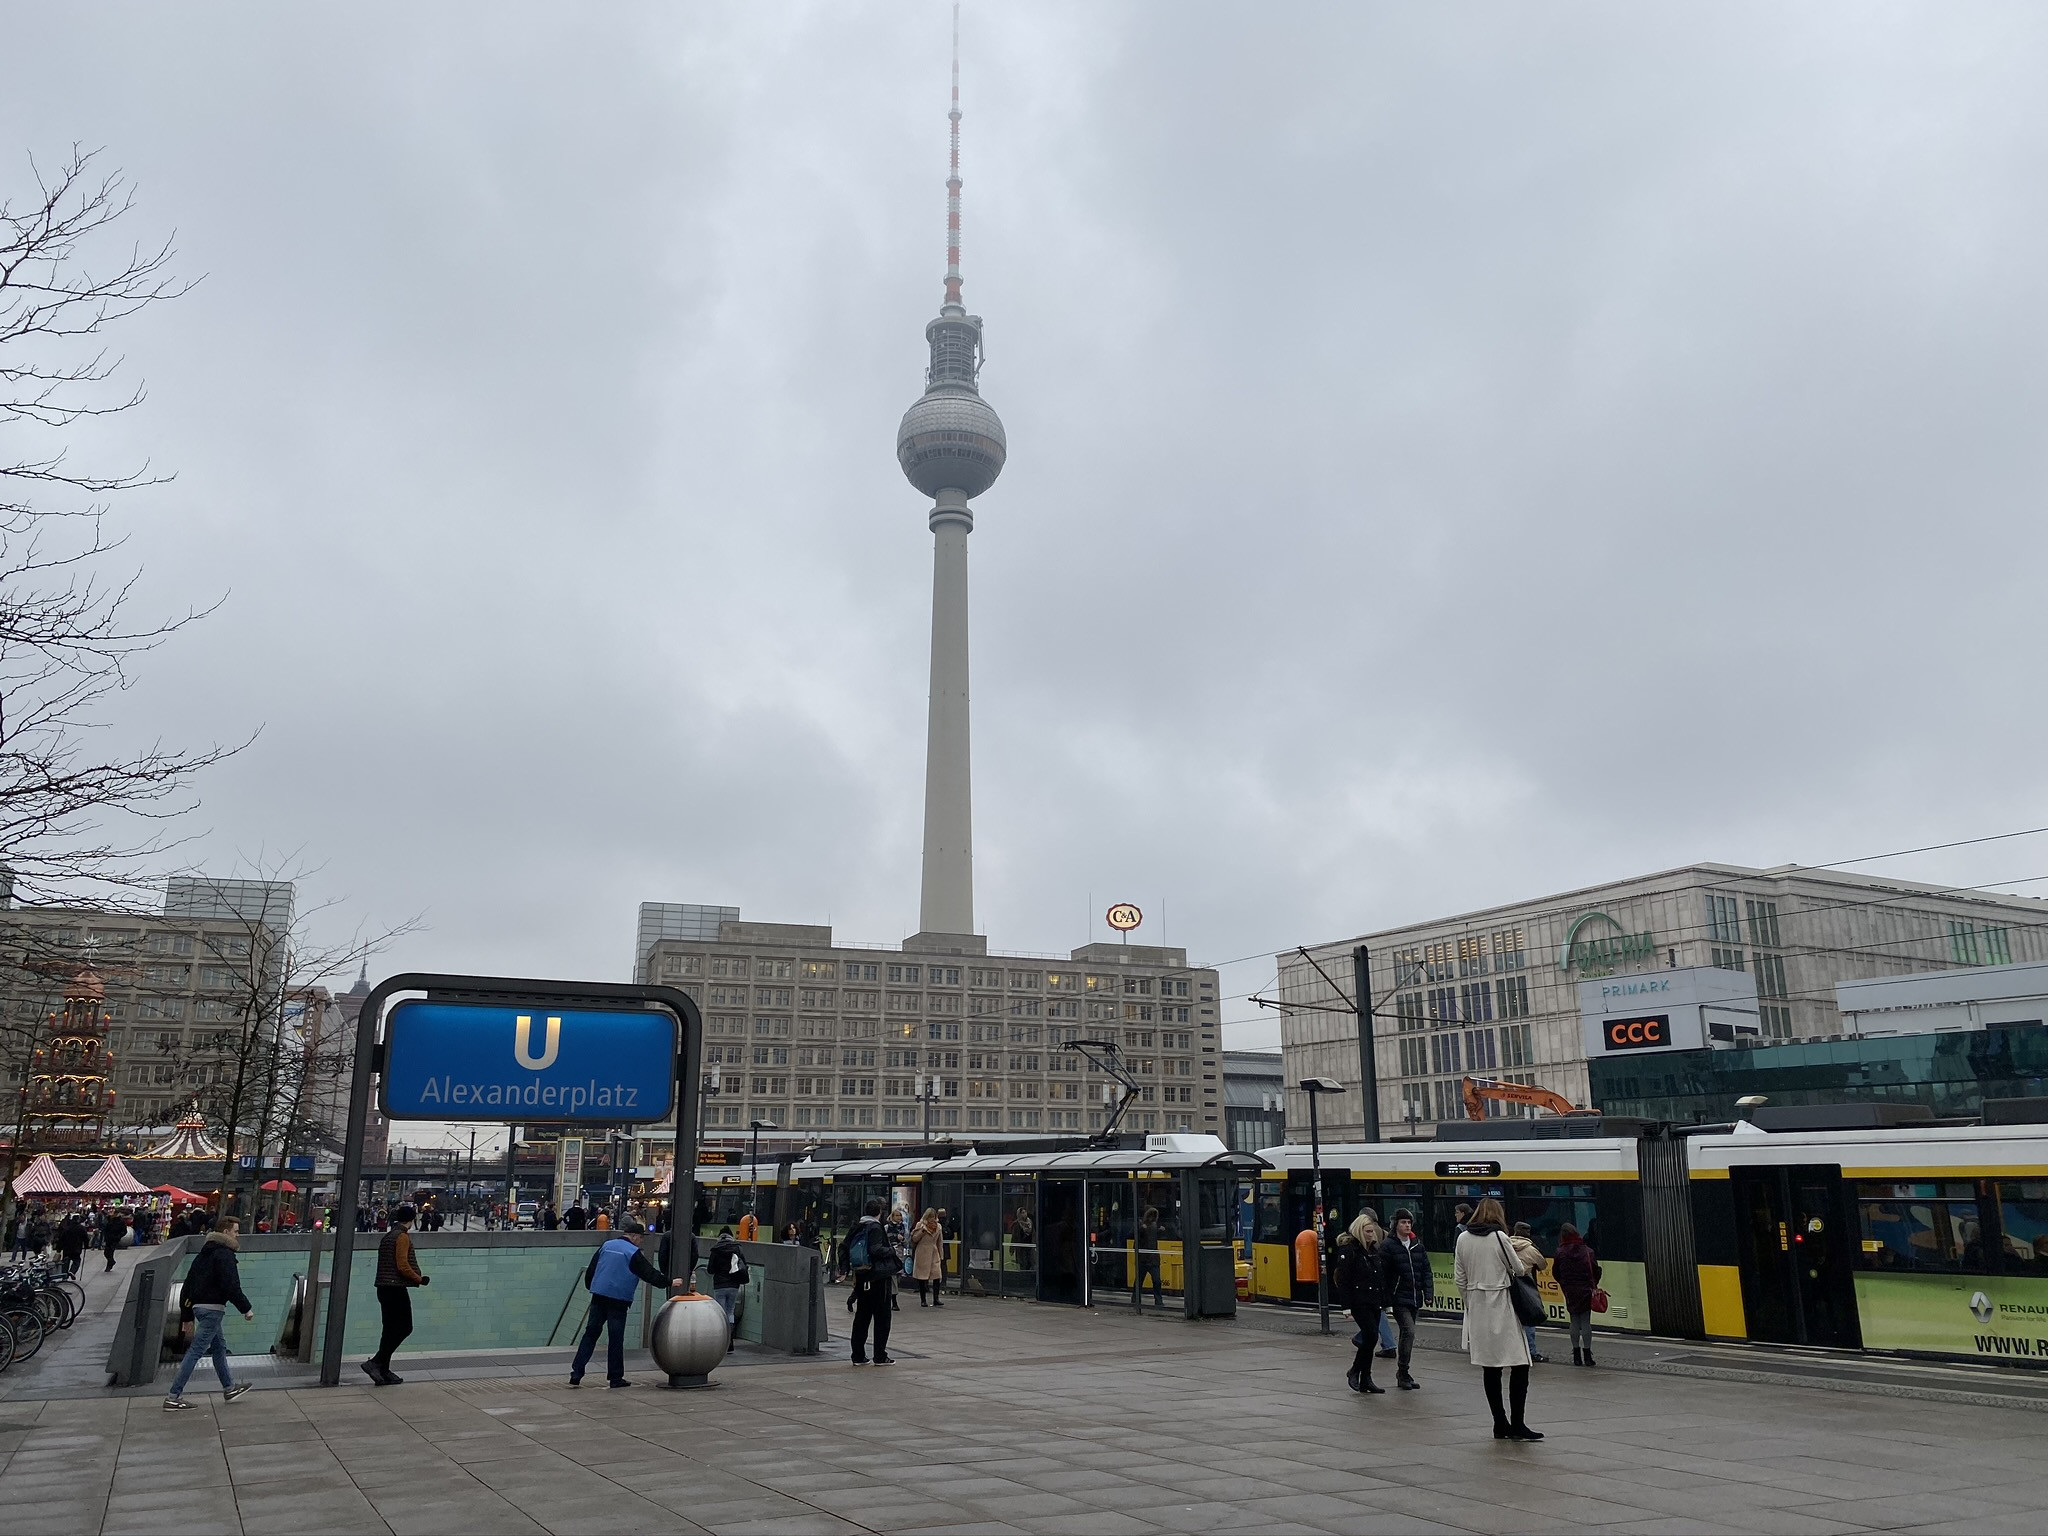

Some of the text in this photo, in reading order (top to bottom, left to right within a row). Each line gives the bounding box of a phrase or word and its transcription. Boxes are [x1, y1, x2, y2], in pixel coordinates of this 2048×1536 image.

[1112, 910, 1137, 923] C&A
[1574, 930, 1657, 973] GALERIA
[1602, 979, 1671, 998] PRIMARK
[514, 1015, 561, 1070] U
[1611, 1021, 1660, 1044] CCC
[419, 1075, 638, 1113] Alexanderplatz
